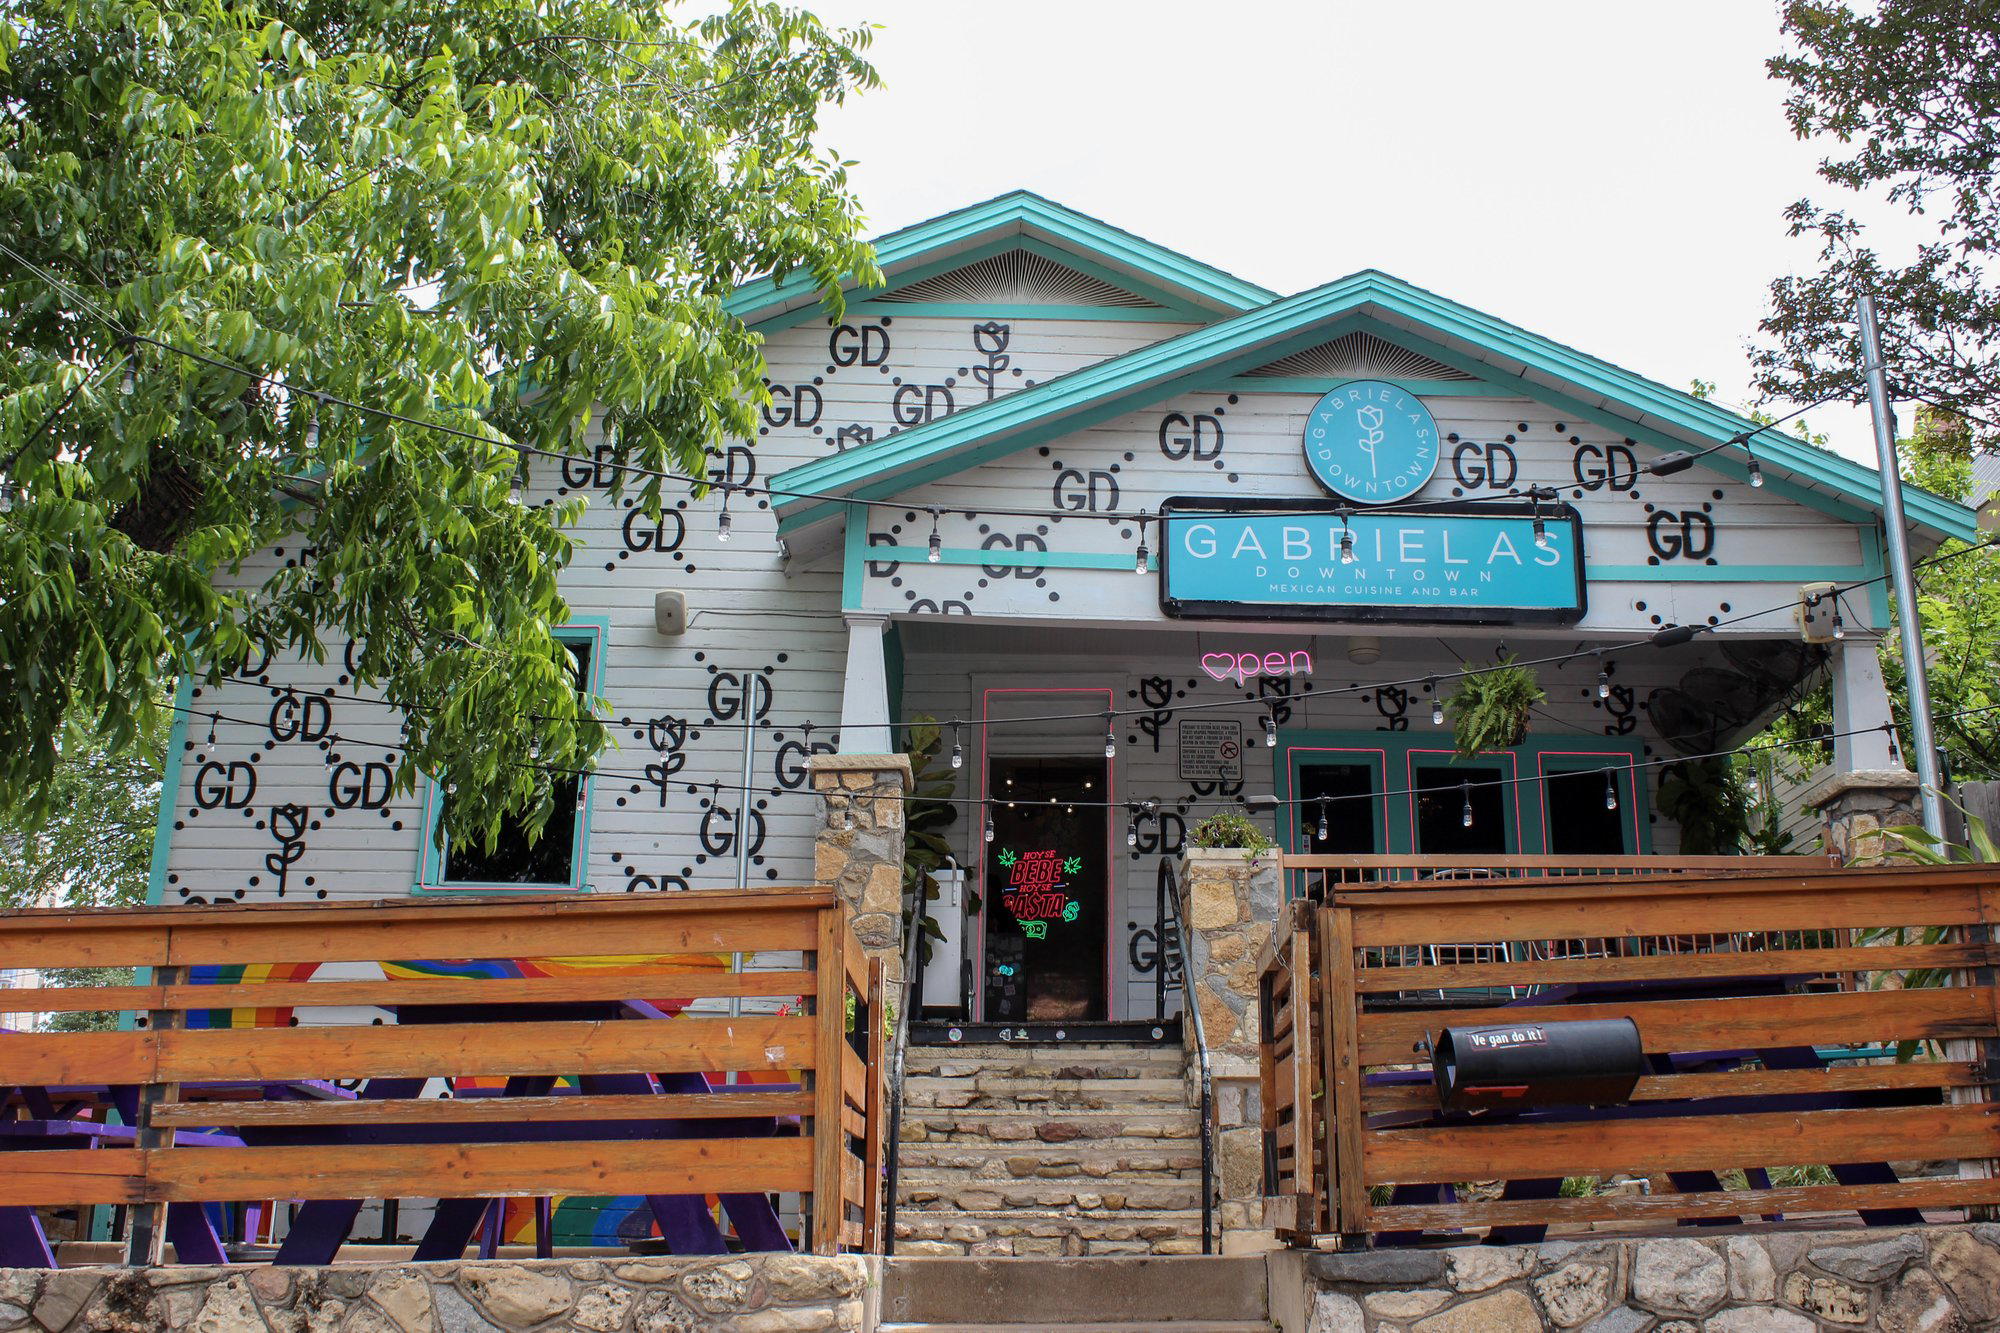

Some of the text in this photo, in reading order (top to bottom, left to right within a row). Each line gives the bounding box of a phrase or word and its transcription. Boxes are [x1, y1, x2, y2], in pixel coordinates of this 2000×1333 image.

[829, 324, 891, 367] GD
[763, 384, 823, 428] GD
[893, 384, 955, 427] GD
[1312, 388, 1429, 439] GABRIELAS
[1158, 413, 1224, 462] GD
[1318, 446, 1430, 494] DOWNTOWN
[1452, 441, 1517, 490] GD
[1573, 443, 1638, 492] GD
[1052, 469, 1120, 512] GD
[622, 507, 686, 552] GD
[1184, 524, 1561, 567] GABRIELAS
[1647, 509, 1715, 560] GD
[1256, 566, 1492, 583] DOWNTOWN
[1269, 584, 1479, 597] MEXICAN CUISINE AND BAR
[269, 696, 332, 742] GD
[193, 761, 258, 810] GD
[329, 761, 394, 810] GD
[1133, 811, 1187, 855] GD
[1010, 859, 1064, 885] BEBE
[1471, 1034, 1486, 1046] Ve
[1488, 1033, 1509, 1047] gan
[1511, 1031, 1525, 1042] do
